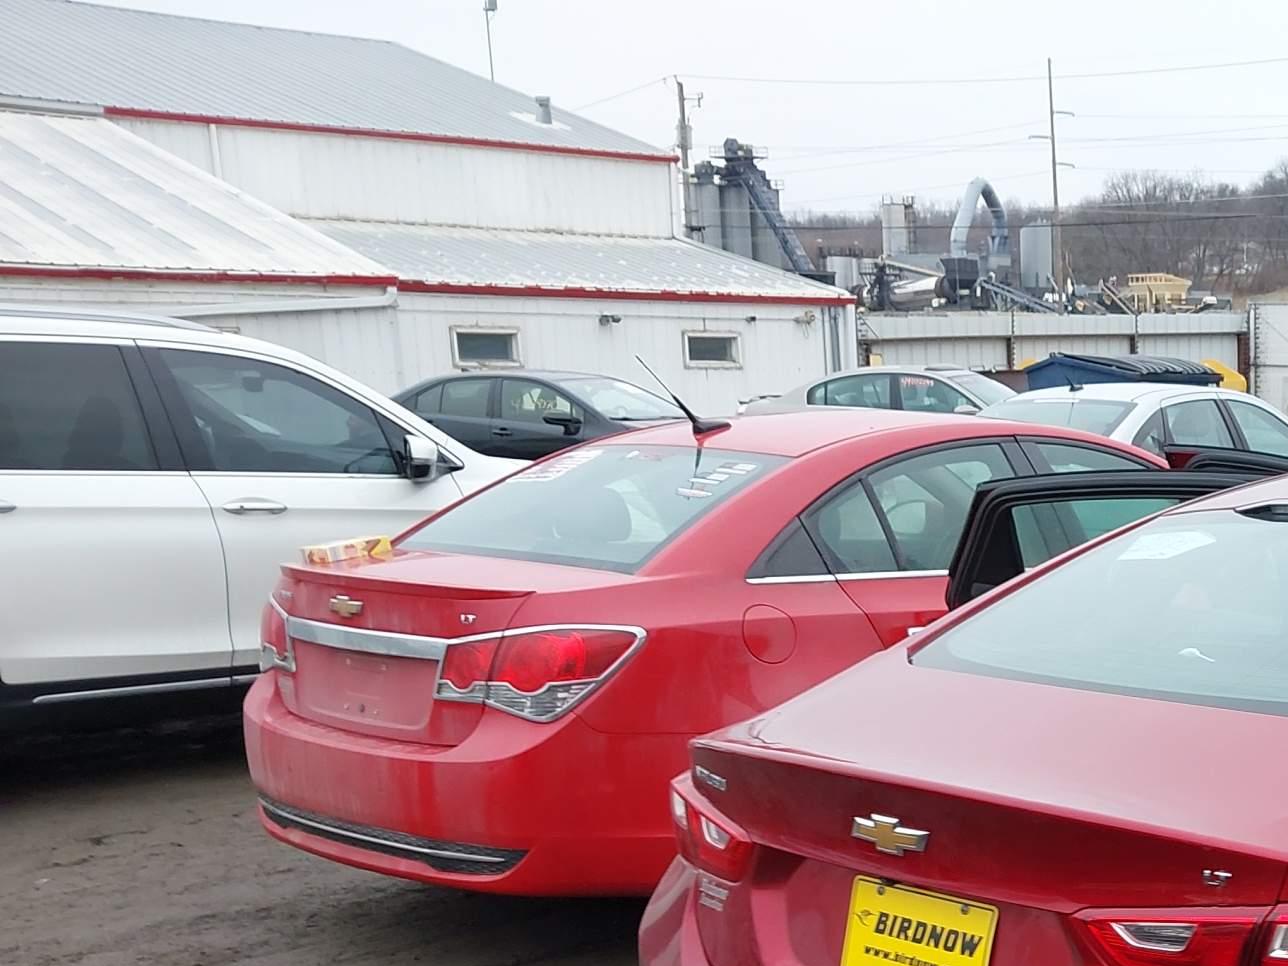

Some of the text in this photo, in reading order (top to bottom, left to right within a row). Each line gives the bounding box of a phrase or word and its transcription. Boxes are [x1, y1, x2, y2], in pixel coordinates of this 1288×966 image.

[459, 614, 477, 624] LT
[1203, 869, 1233, 887] LT
[874, 911, 983, 958] BIRDNOW
